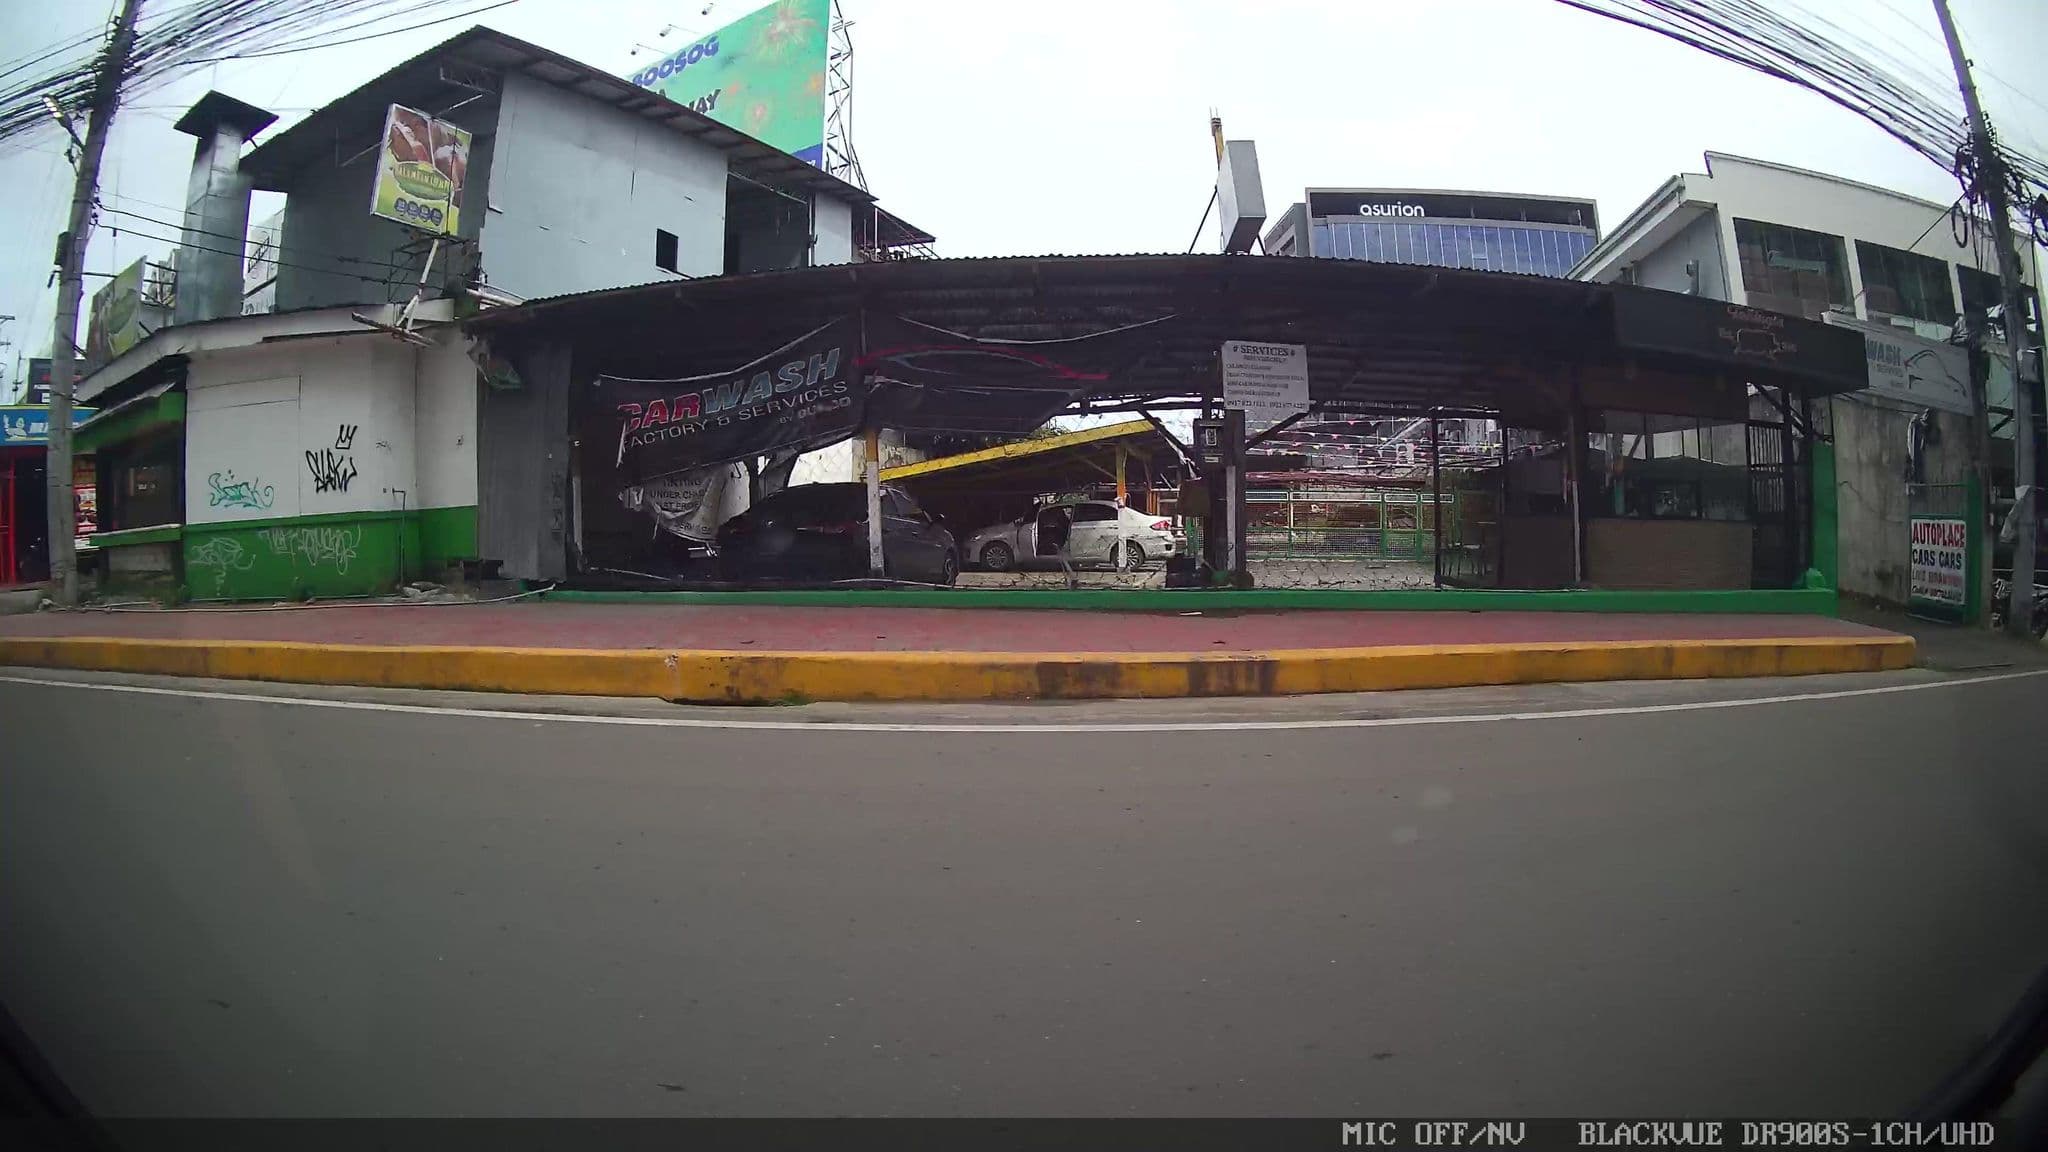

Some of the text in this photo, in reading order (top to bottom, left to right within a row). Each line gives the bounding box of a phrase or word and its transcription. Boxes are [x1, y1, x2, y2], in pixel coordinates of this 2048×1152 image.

[1360, 201, 1425, 217] asurion
[1240, 345, 1289, 356] SERVICES
[617, 348, 840, 434] CARWASH
[739, 381, 848, 420] SERVICES
[1912, 522, 1965, 548] AUTOPLACE
[1912, 549, 1962, 570] CARS CARS
